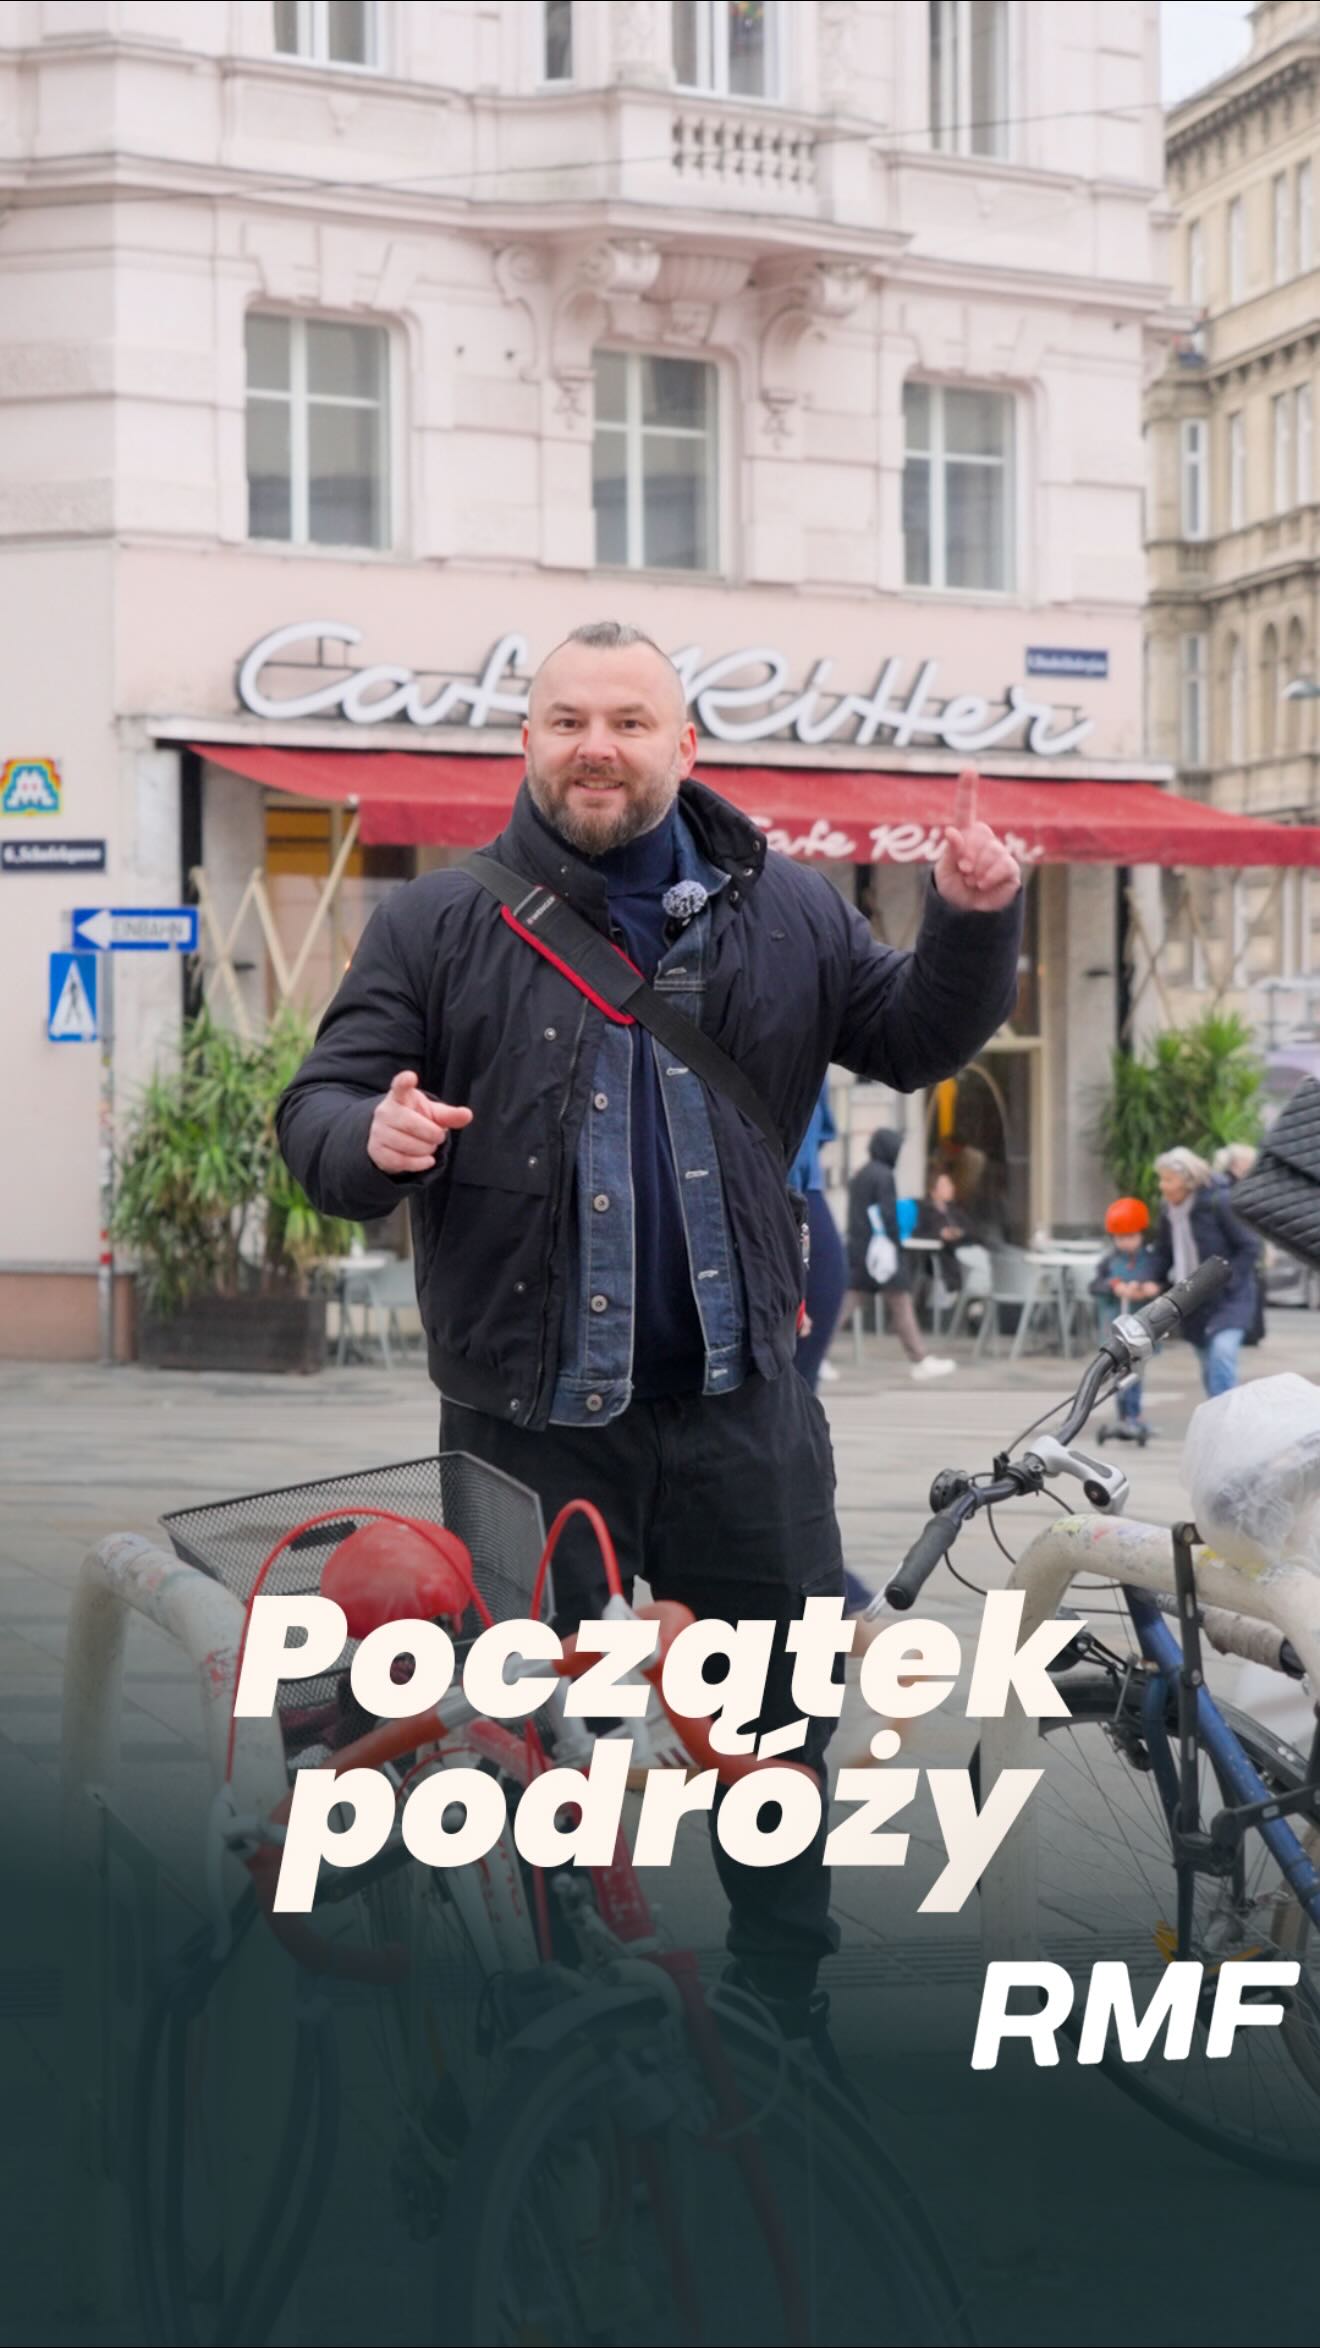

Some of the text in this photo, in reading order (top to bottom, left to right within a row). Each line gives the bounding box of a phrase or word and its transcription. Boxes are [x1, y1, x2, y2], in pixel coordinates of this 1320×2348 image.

[238, 621, 1094, 754] Caf Ritter
[869, 823, 1045, 862] Rir
